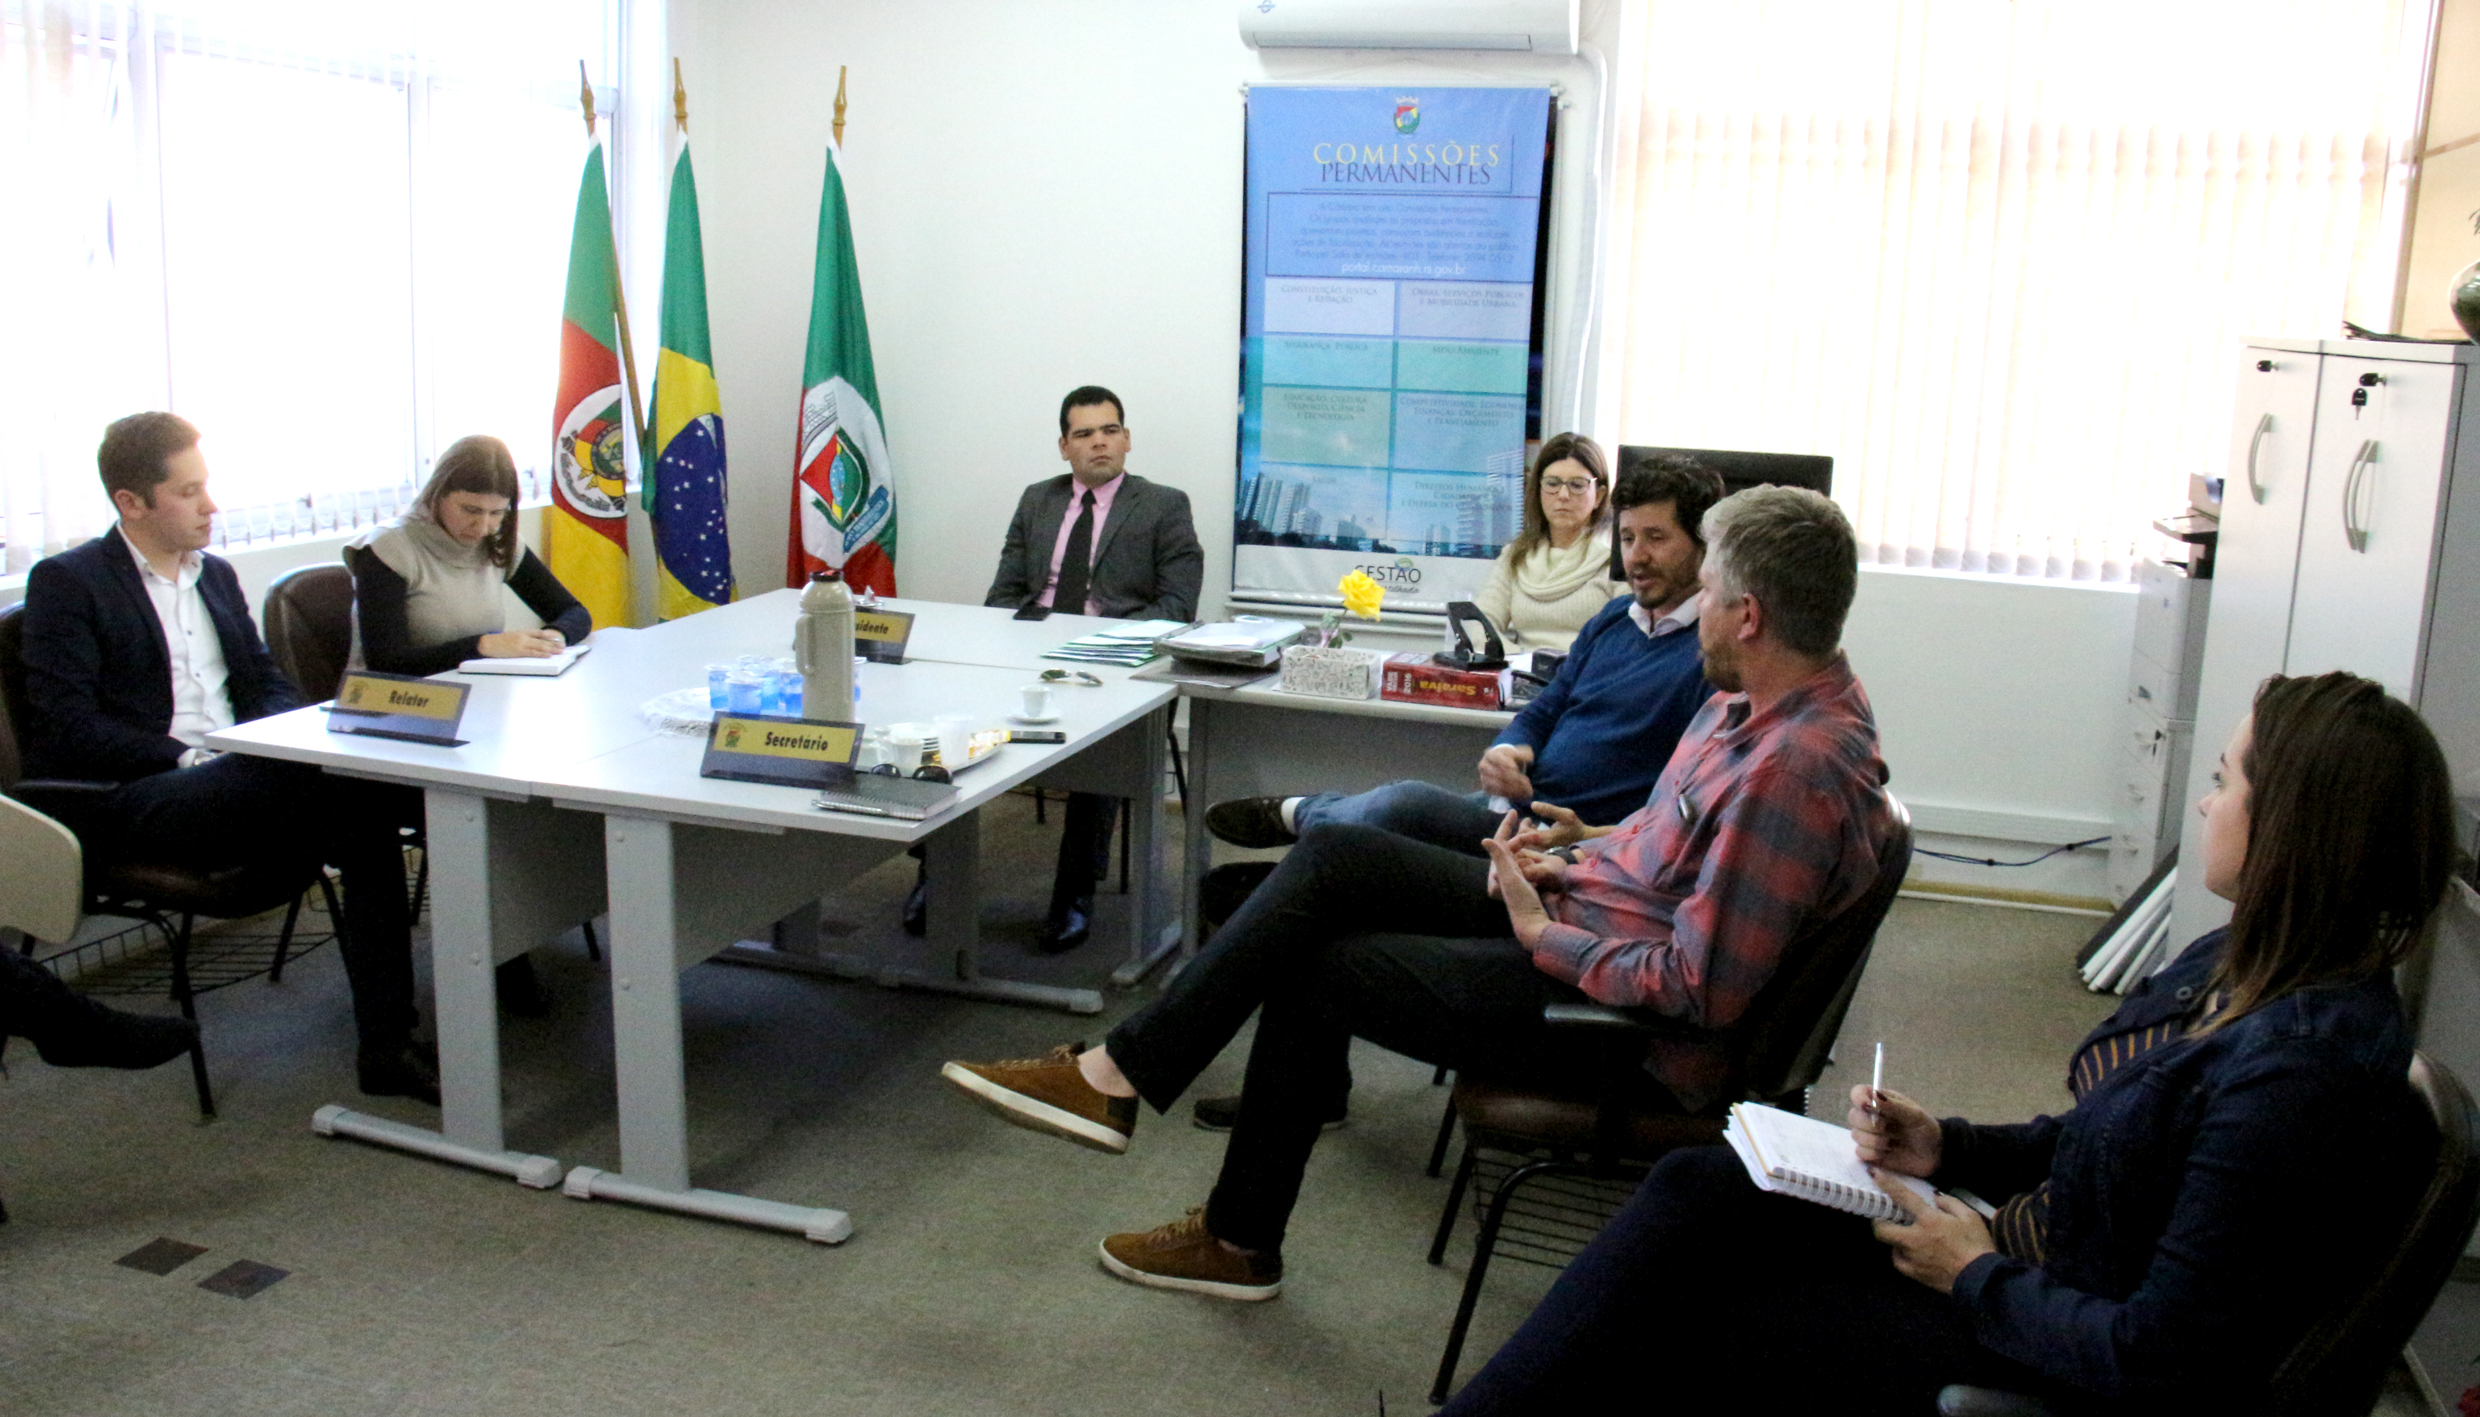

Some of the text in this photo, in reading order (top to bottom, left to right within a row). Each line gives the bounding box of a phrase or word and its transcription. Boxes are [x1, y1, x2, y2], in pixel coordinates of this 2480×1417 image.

[1313, 141, 1499, 166] COMISSÕES
[1321, 162, 1490, 184] PERMANENTES
[855, 619, 889, 634] sidente
[1403, 673, 1412, 694] 2016
[1419, 680, 1477, 696] Saraiva
[389, 690, 429, 708] Relator
[765, 731, 829, 751] Secretário
